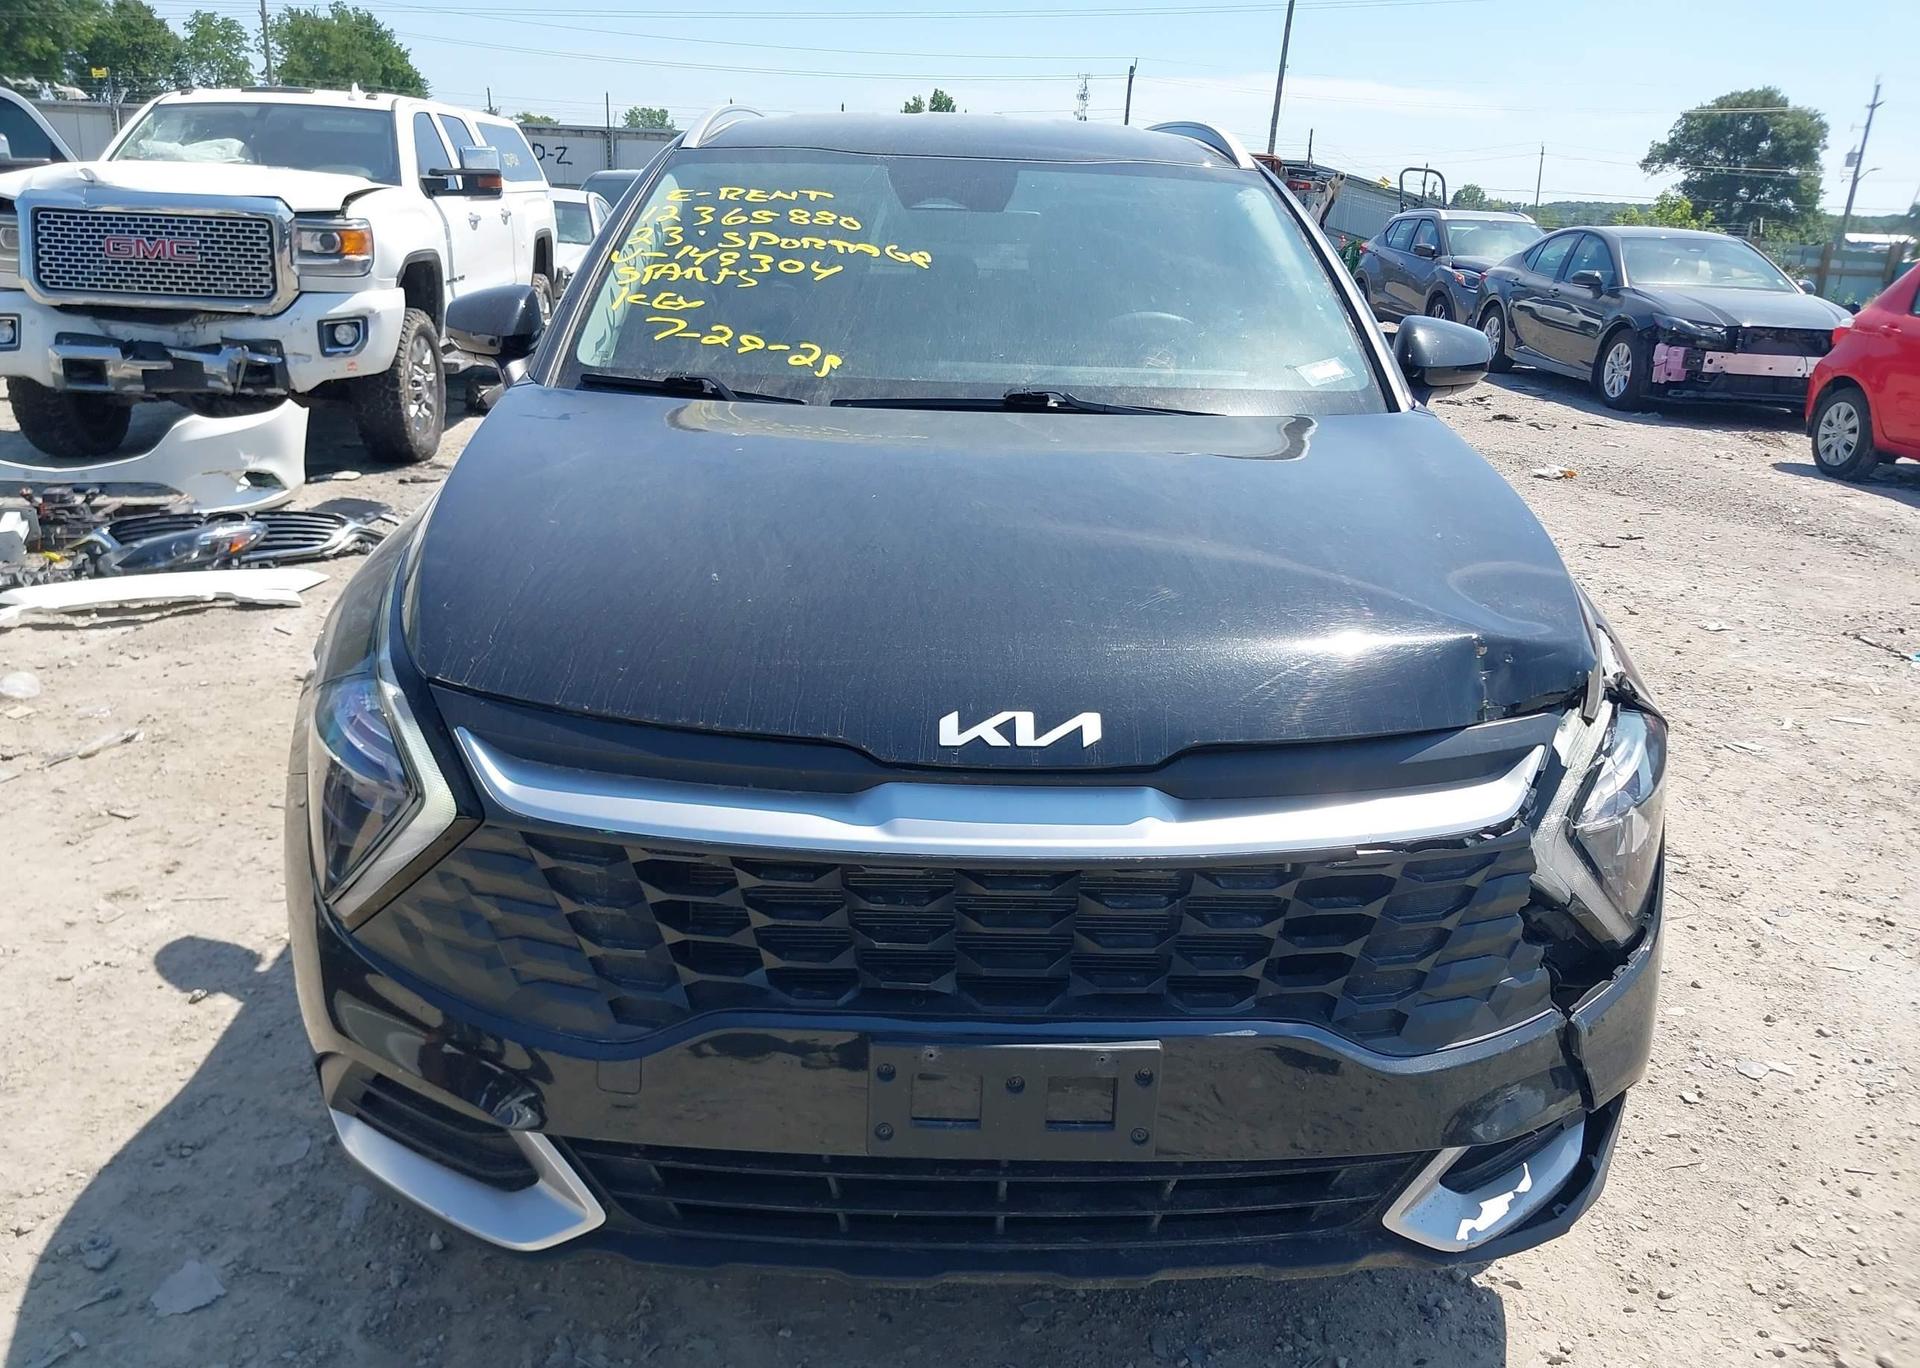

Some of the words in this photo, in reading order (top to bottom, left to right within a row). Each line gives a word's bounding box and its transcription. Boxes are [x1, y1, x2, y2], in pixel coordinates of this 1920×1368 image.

[666, 187, 834, 202] E-RENT
[104, 235, 201, 261] GMC
[939, 710, 1102, 748] KIA
